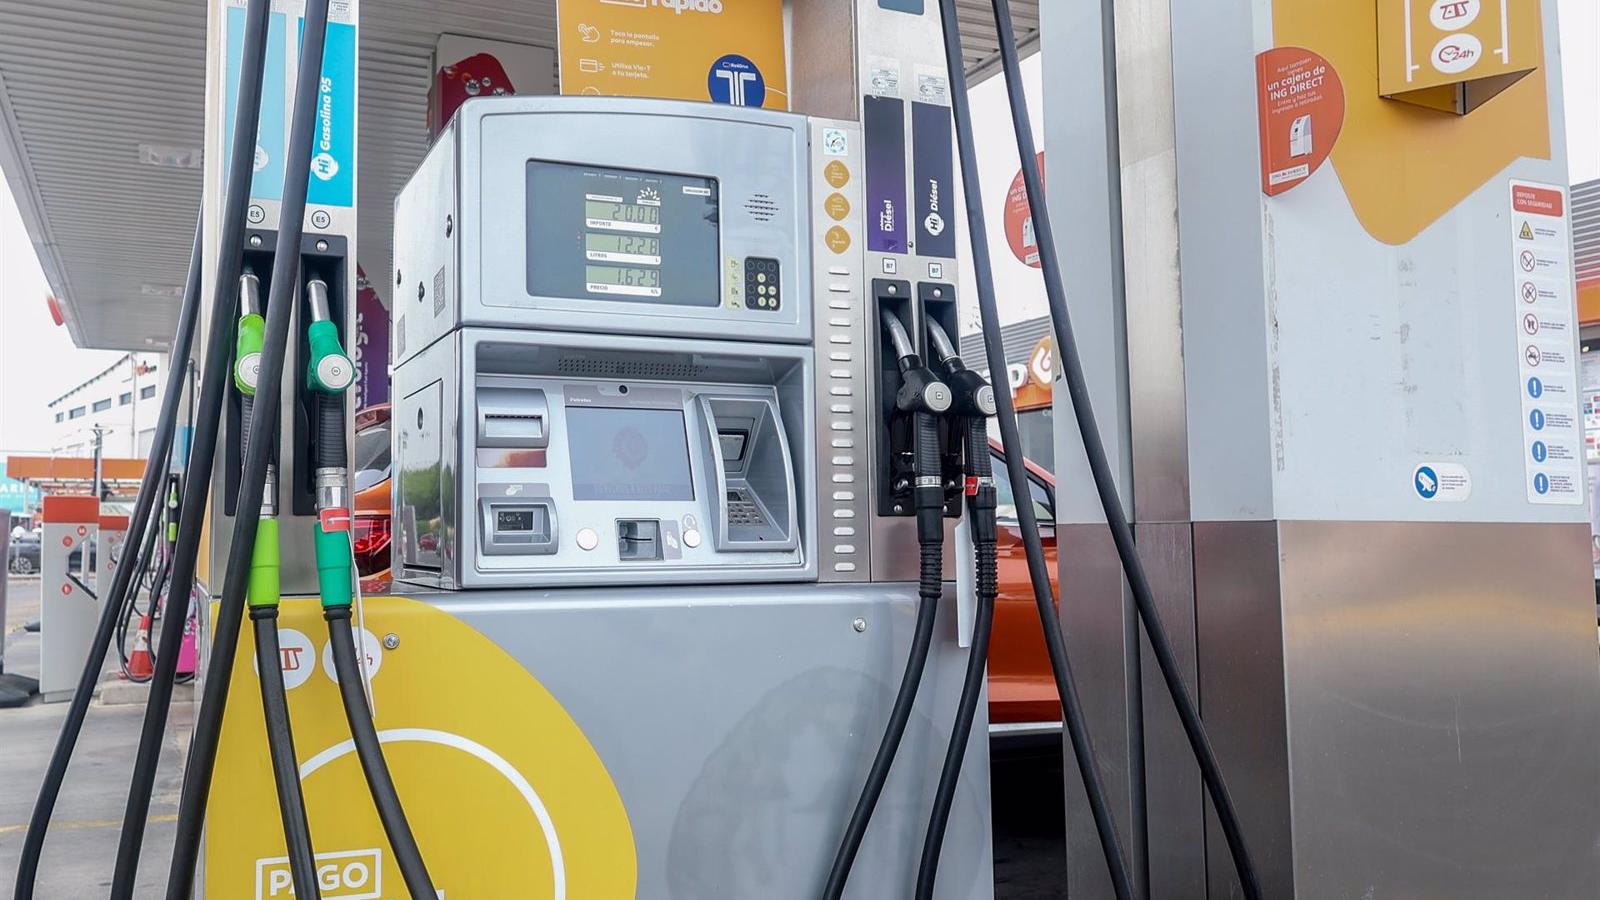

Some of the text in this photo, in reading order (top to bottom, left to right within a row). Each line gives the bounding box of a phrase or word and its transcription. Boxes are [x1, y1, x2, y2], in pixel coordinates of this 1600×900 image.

[1452, 49, 1474, 61] 24h
[1267, 64, 1326, 91] un cajero de
[1269, 76, 1324, 101] ING DIRECT
[318, 77, 332, 174] Hi Gasolina 95
[250, 210, 260, 218] E5
[612, 204, 658, 224] 20.00
[883, 199, 892, 231] Diésel
[929, 179, 938, 230] Hi Diésel
[315, 215, 326, 223] E5
[617, 236, 658, 255] 12.28
[617, 269, 658, 287] 1.629
[269, 861, 369, 897] PGO
